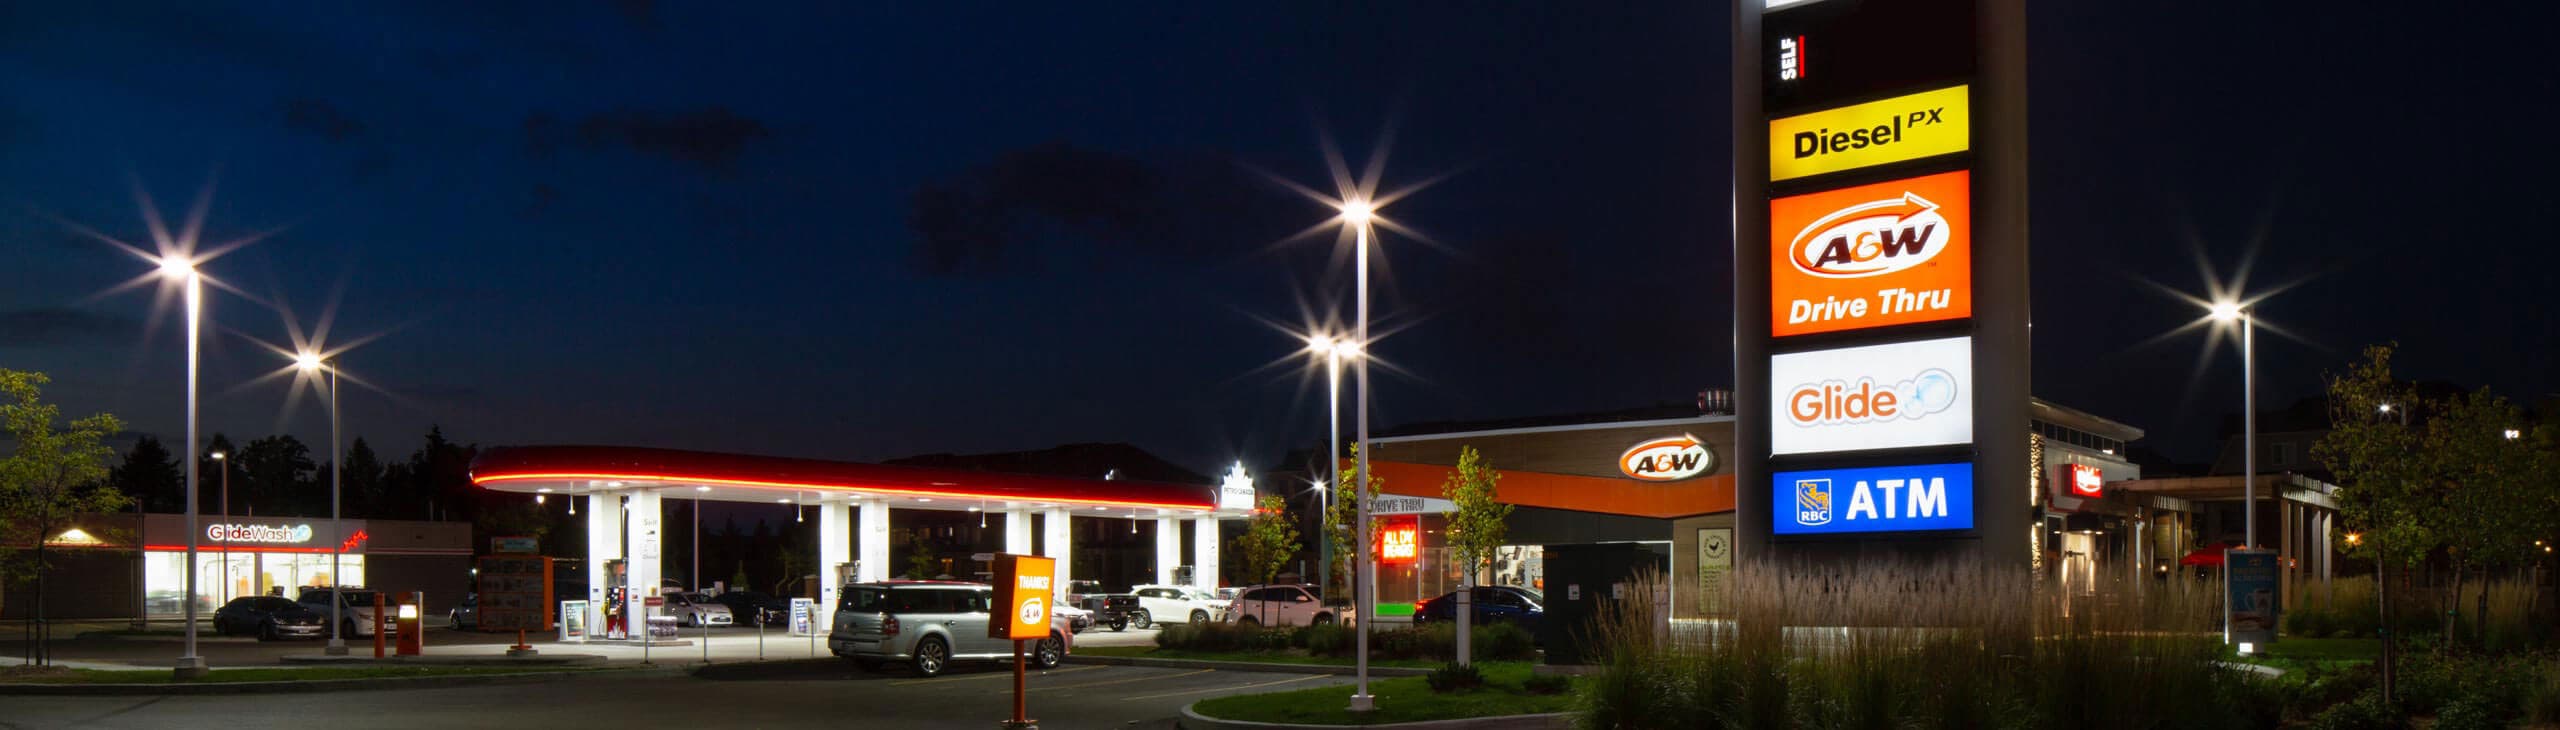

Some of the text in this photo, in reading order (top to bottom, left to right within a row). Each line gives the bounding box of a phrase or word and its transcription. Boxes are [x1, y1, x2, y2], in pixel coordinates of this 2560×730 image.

[1781, 38, 1797, 81] SELF
[1794, 107, 1945, 159] Diesel PX
[1813, 221, 1938, 267] A&W
[1789, 287, 1951, 325] Drive Thru
[1791, 382, 1897, 422] Glide
[1633, 452, 1702, 474] A&W
[1400, 497, 1425, 512] THRU
[1801, 510, 1828, 521] RBC
[1846, 477, 1948, 520] ATM
[209, 526, 293, 541] GideWash
